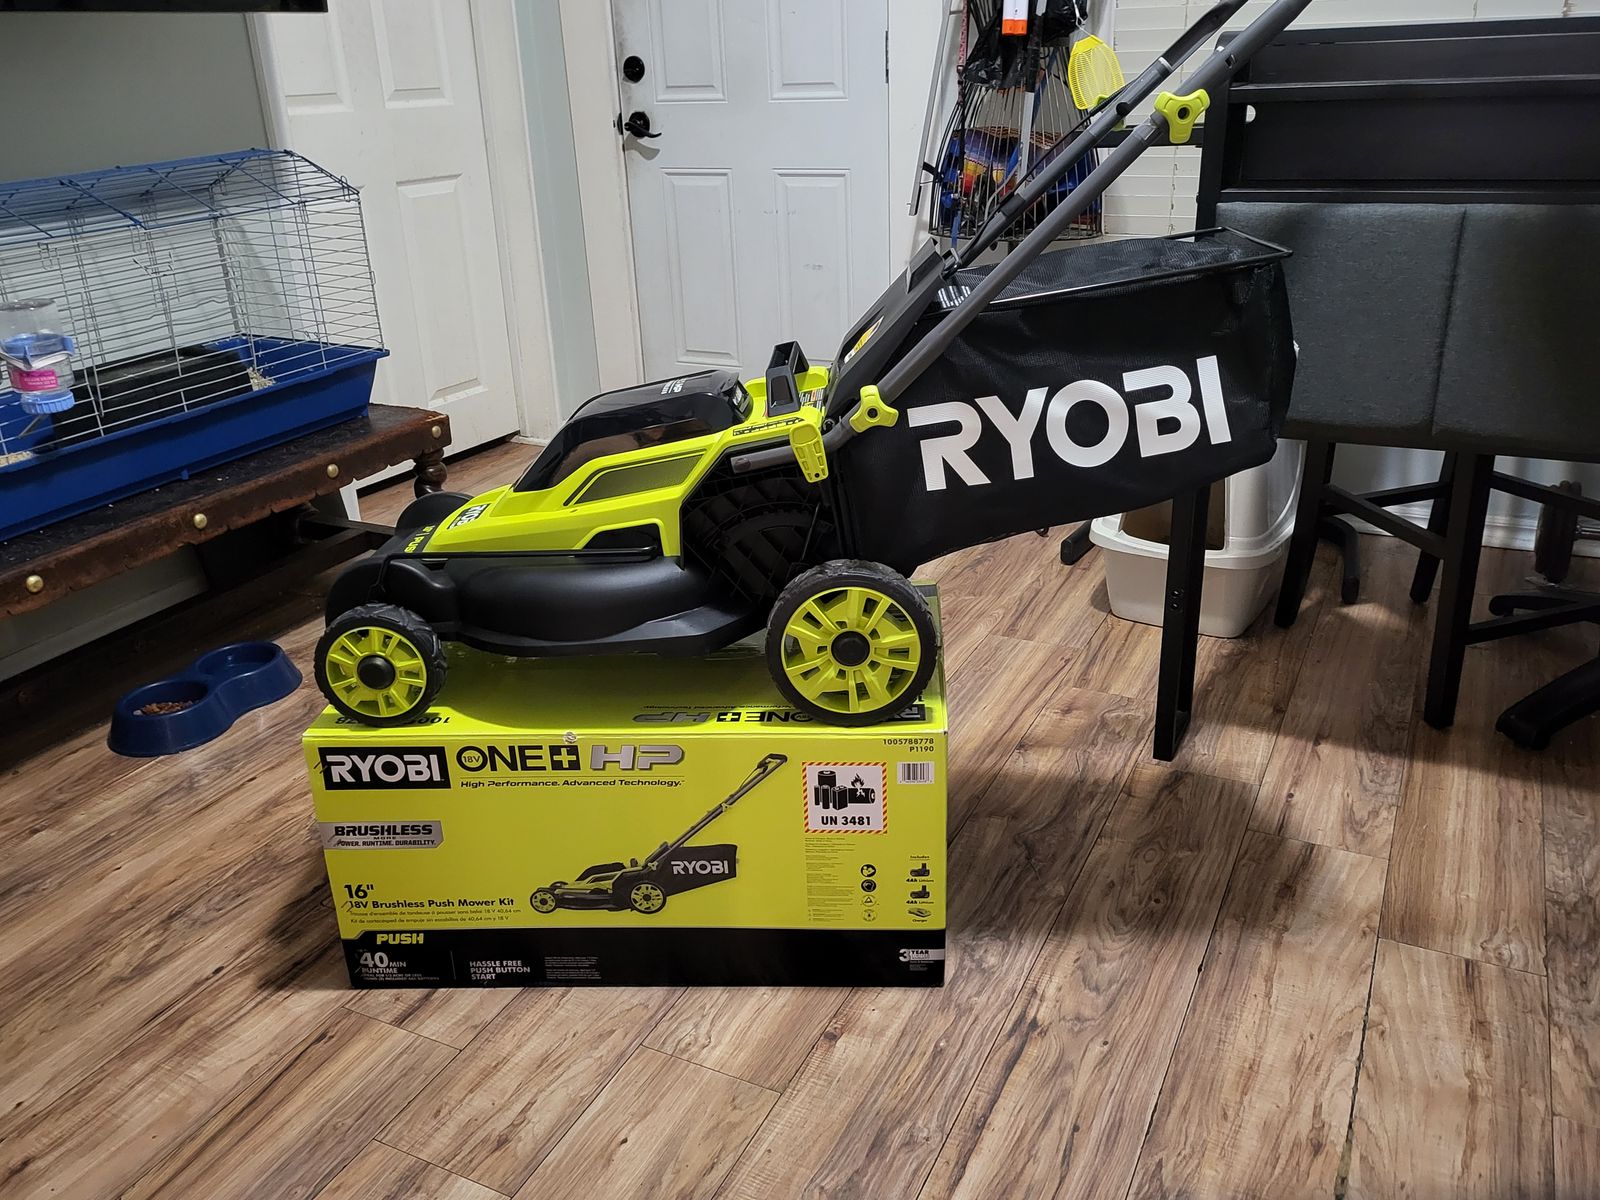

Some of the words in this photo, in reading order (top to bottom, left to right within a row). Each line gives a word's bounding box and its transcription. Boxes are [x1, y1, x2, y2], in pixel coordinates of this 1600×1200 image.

[906, 355, 1232, 492] RYOBI
[882, 737, 935, 746] 1005788778
[462, 755, 482, 764] 18V
[590, 744, 685, 771] HP
[326, 754, 441, 783] RYOBI
[461, 779, 485, 789] High
[488, 779, 560, 788] Performance.
[562, 778, 616, 787] Advanced
[618, 778, 682, 788] Technology.
[820, 815, 838, 826] UN
[841, 815, 871, 826] 3481
[334, 824, 433, 837] BRUSHLESS
[670, 859, 729, 875] RYOBI
[344, 884, 374, 899] 16"
[350, 900, 368, 909] 18V
[372, 899, 425, 909] Brushless
[428, 899, 454, 908] Push
[457, 898, 496, 907] Mower
[499, 898, 514, 906] Kit
[376, 932, 424, 945] PUSH
[360, 952, 389, 968] 40
[361, 967, 398, 975] RUNTIME
[495, 966, 531, 974] BUTTON
[471, 973, 496, 981] START
